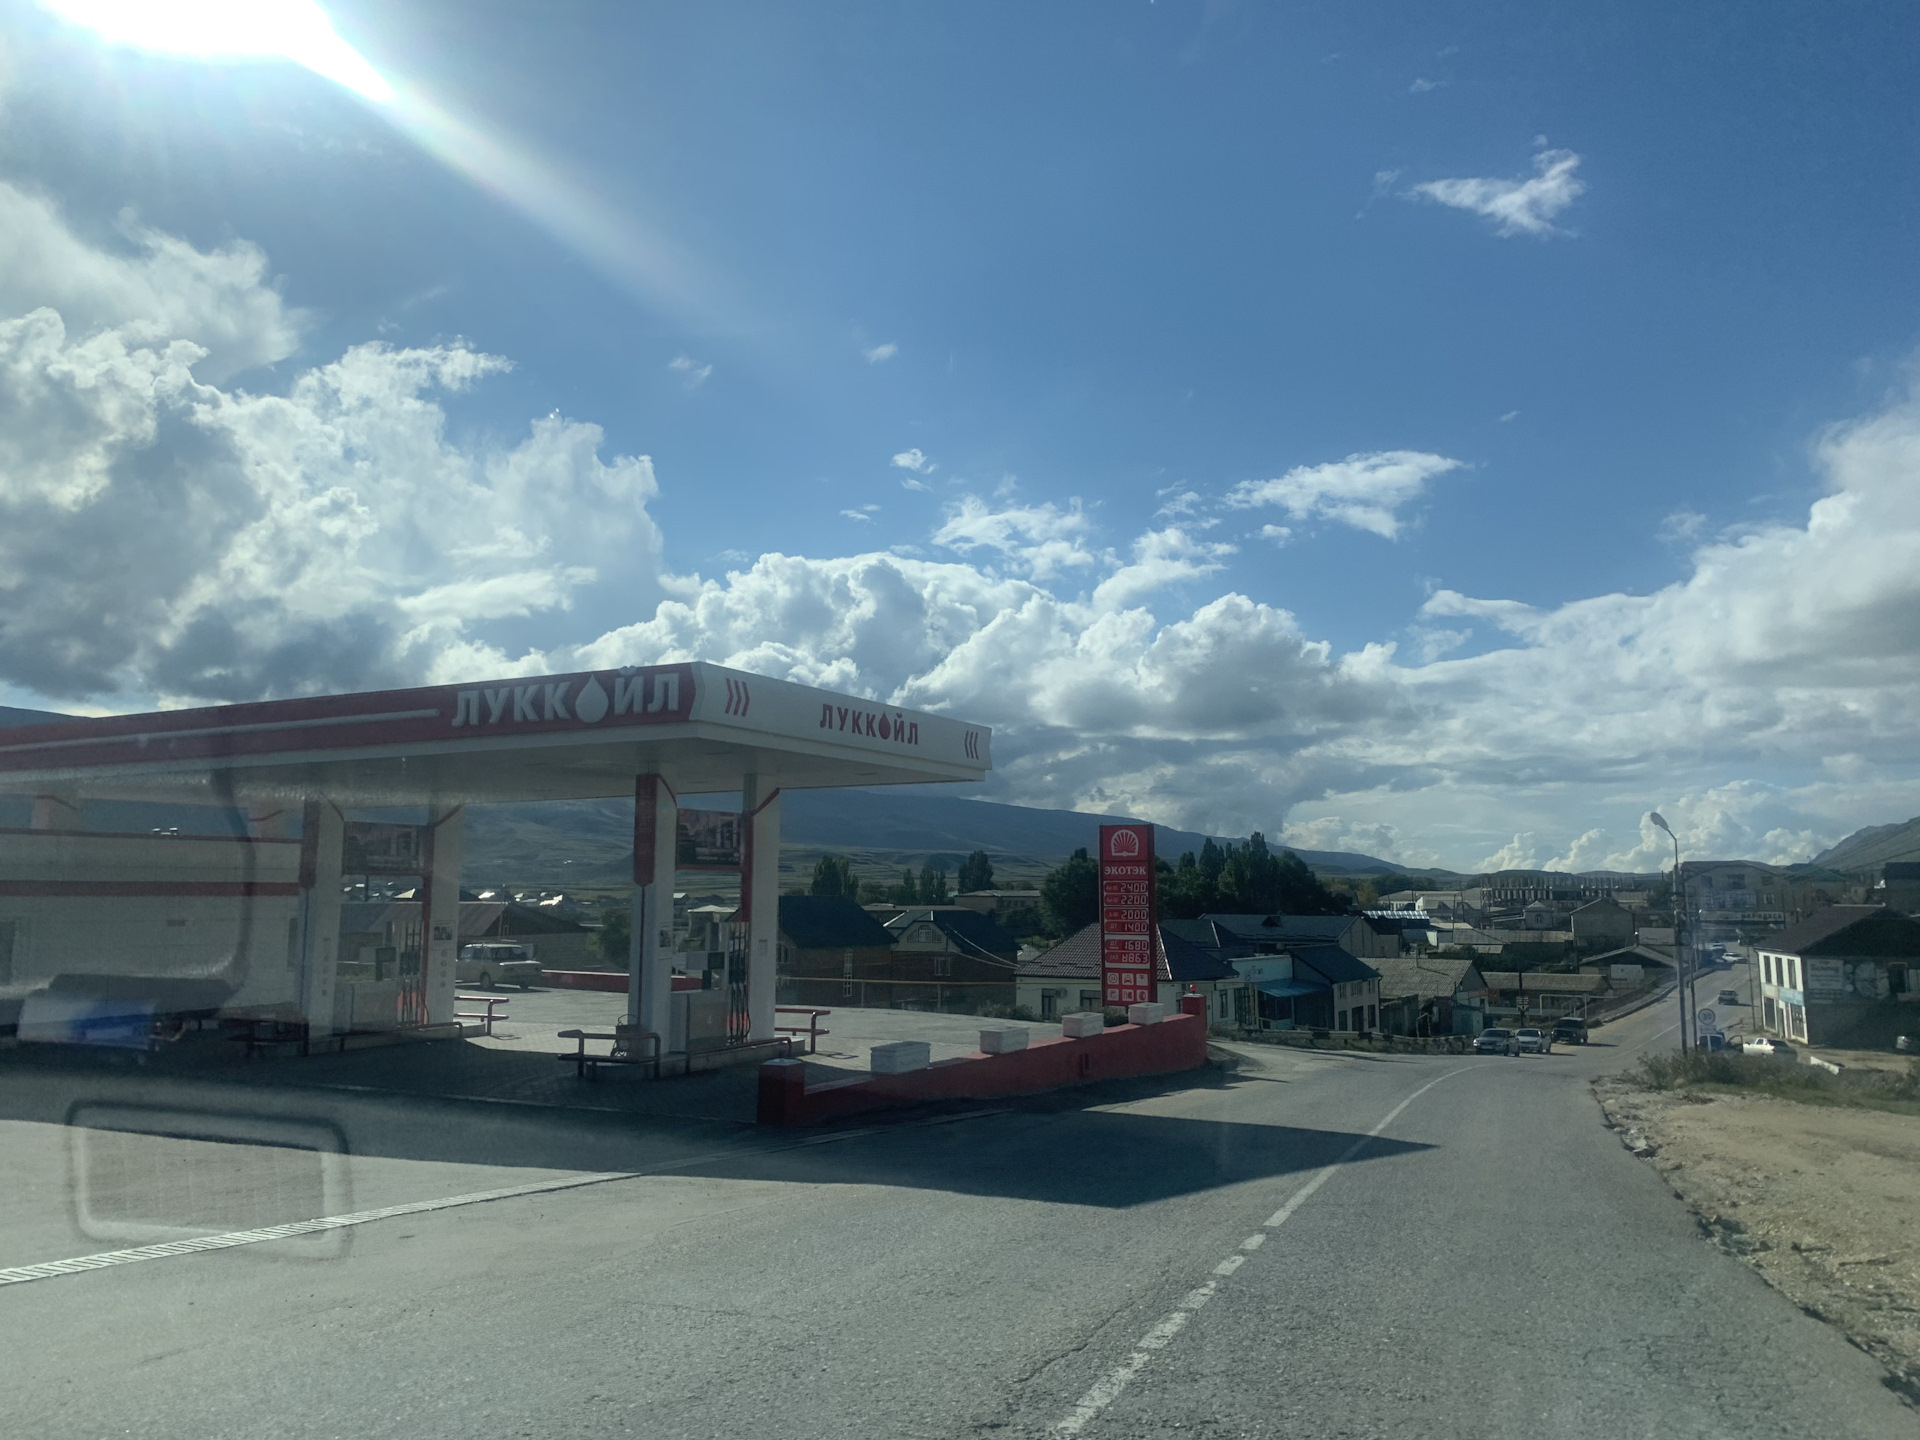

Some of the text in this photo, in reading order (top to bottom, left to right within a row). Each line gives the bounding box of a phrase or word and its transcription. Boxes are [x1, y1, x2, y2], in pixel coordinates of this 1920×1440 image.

[819, 703, 918, 745] ЛУККОЙЛ
[1104, 866, 1146, 875] ЭКОТЭК
[1121, 883, 1147, 892] 2400
[1121, 895, 1147, 904] 2200
[1124, 922, 1147, 932] 1400
